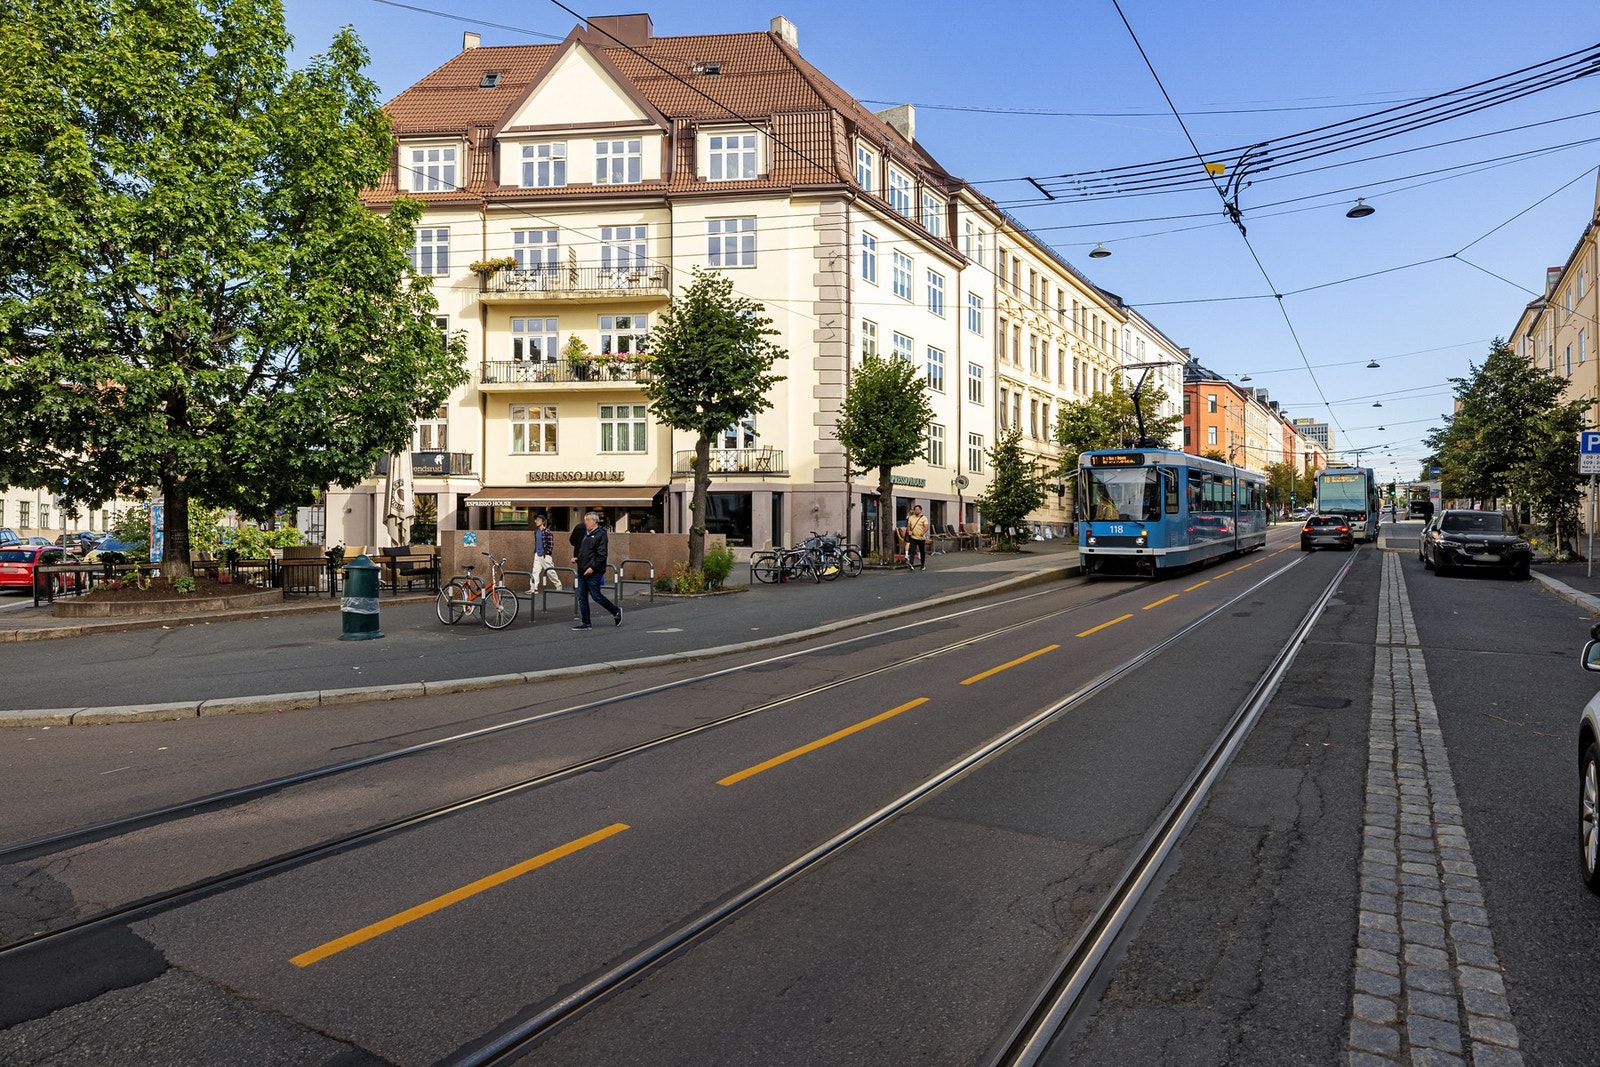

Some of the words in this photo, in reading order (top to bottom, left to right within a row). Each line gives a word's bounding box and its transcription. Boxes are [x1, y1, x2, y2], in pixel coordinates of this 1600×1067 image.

[1587, 434, 1600, 452] P
[528, 471, 583, 482] ESPRESSO
[585, 471, 625, 482] HOUSE
[1110, 525, 1124, 534] 118
